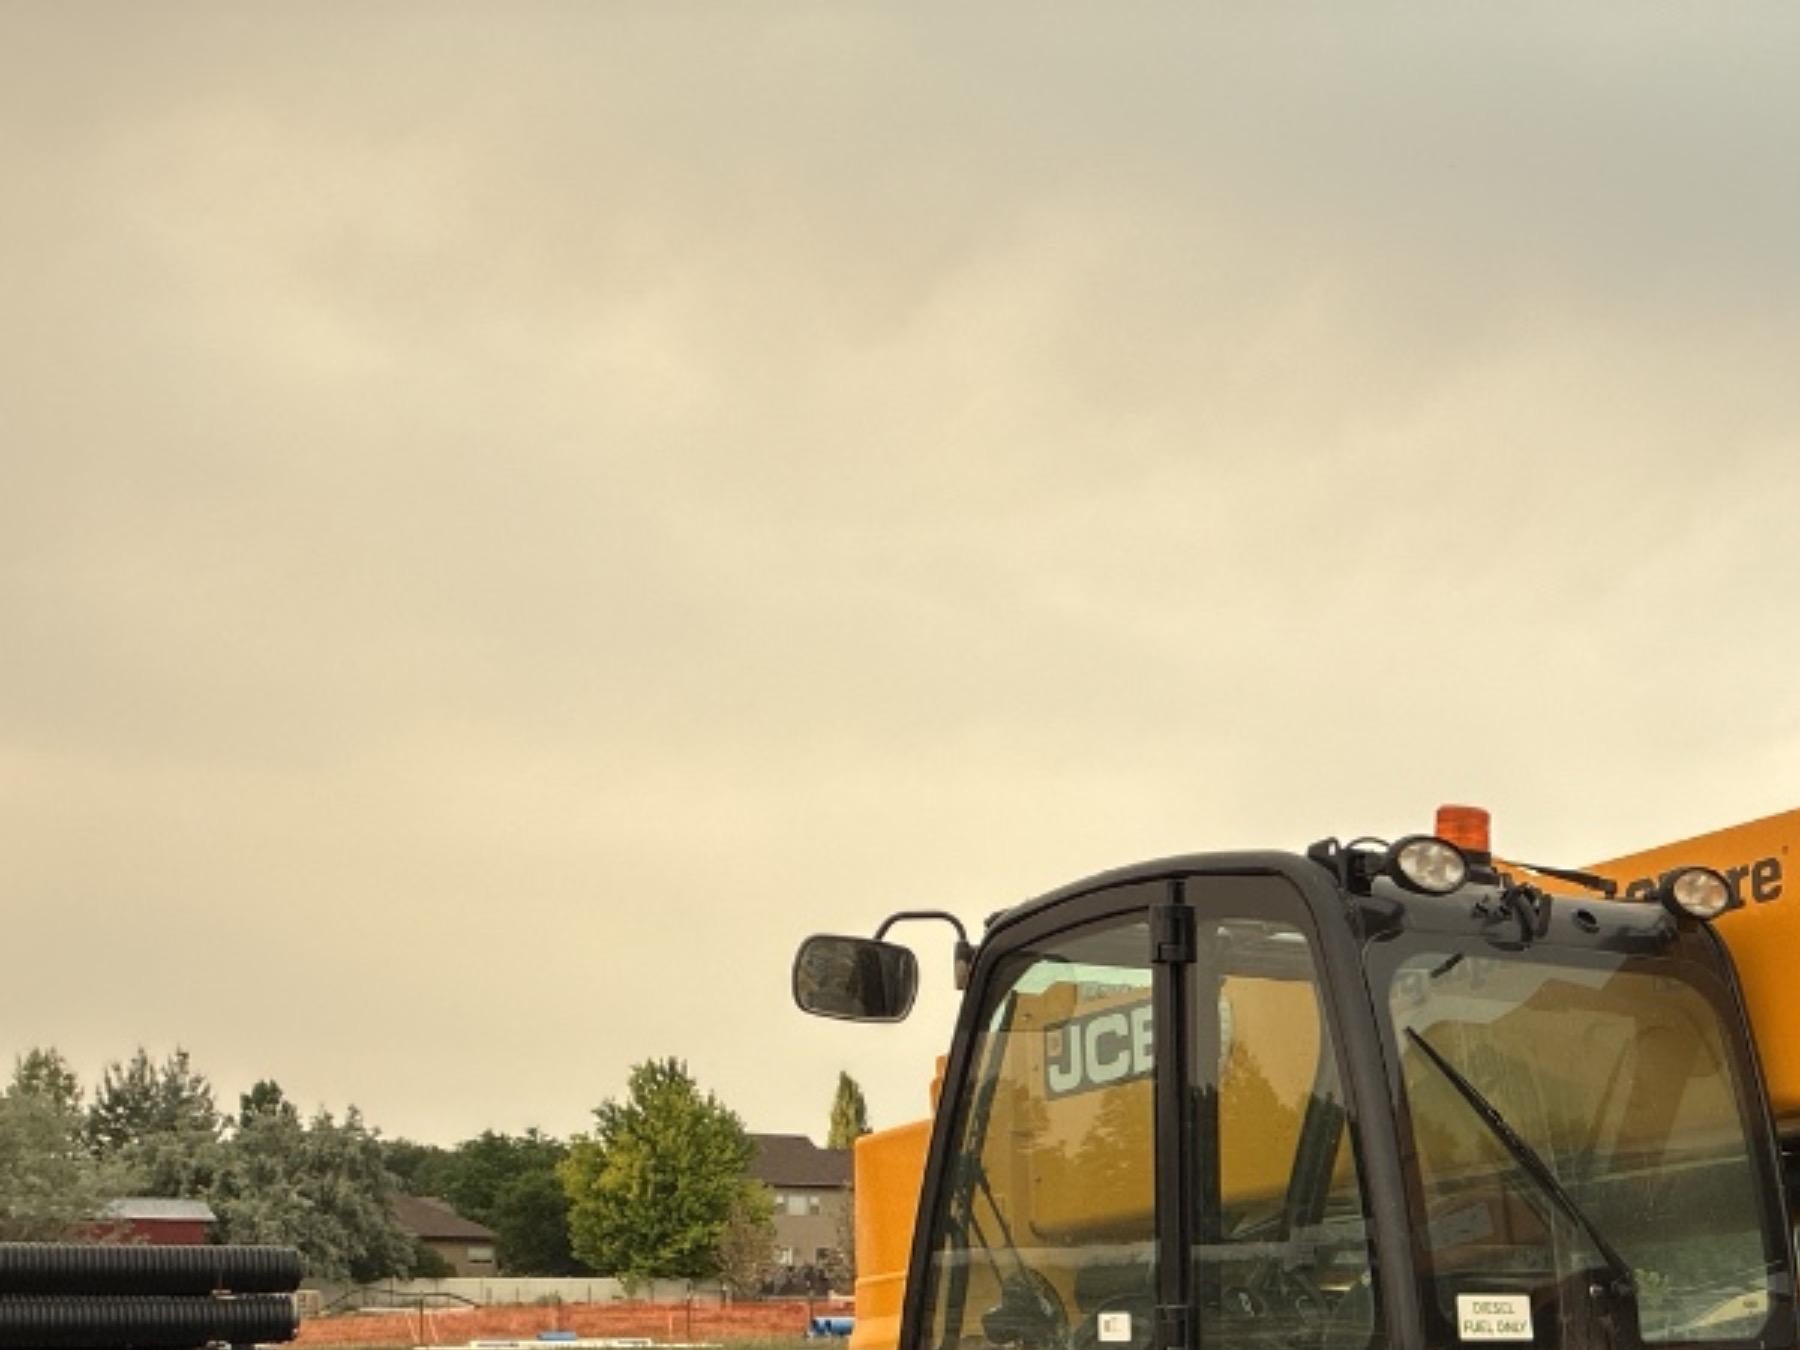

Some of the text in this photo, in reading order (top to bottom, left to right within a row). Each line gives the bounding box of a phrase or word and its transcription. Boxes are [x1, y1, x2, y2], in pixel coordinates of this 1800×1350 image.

[1473, 1302, 1516, 1315] DIESEL
[1464, 1320, 1528, 1334] FUEL ONLY
